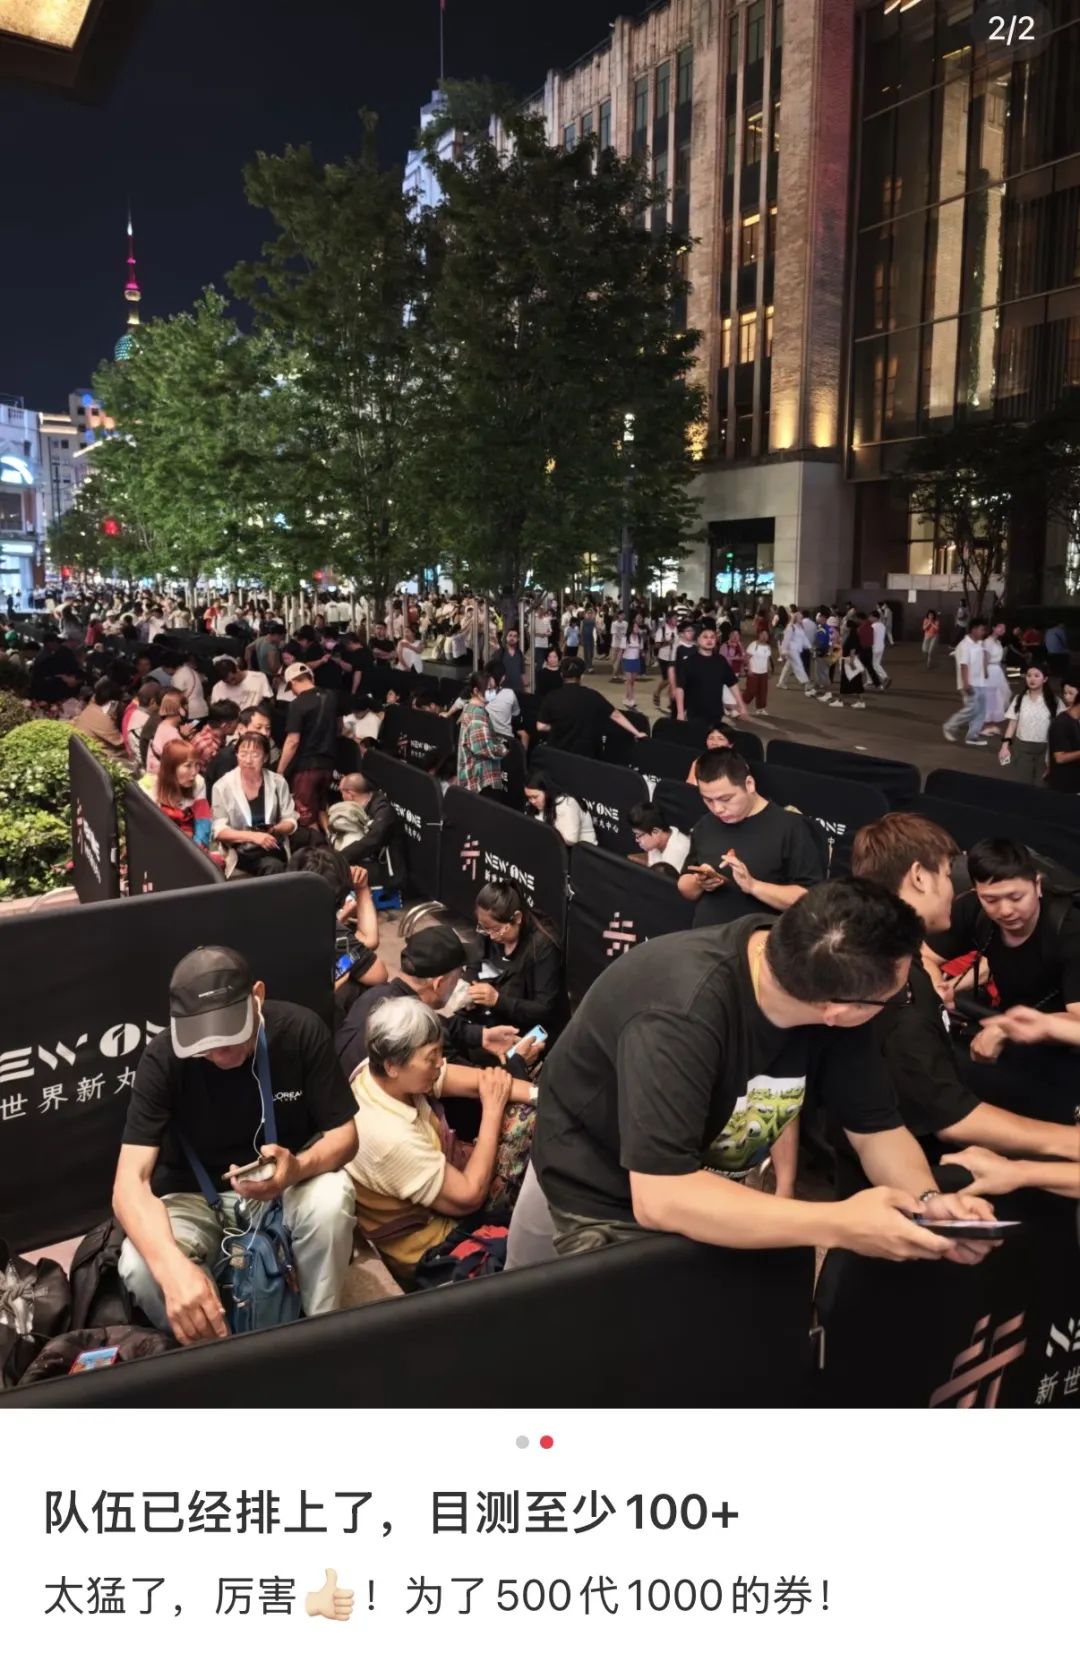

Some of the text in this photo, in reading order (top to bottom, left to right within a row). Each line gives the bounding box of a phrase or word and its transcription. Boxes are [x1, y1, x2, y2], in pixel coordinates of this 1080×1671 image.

[596, 802, 620, 820] ONE
[484, 851, 510, 873] NEW
[509, 864, 535, 891] ONE
[0, 1032, 88, 1083] EW
